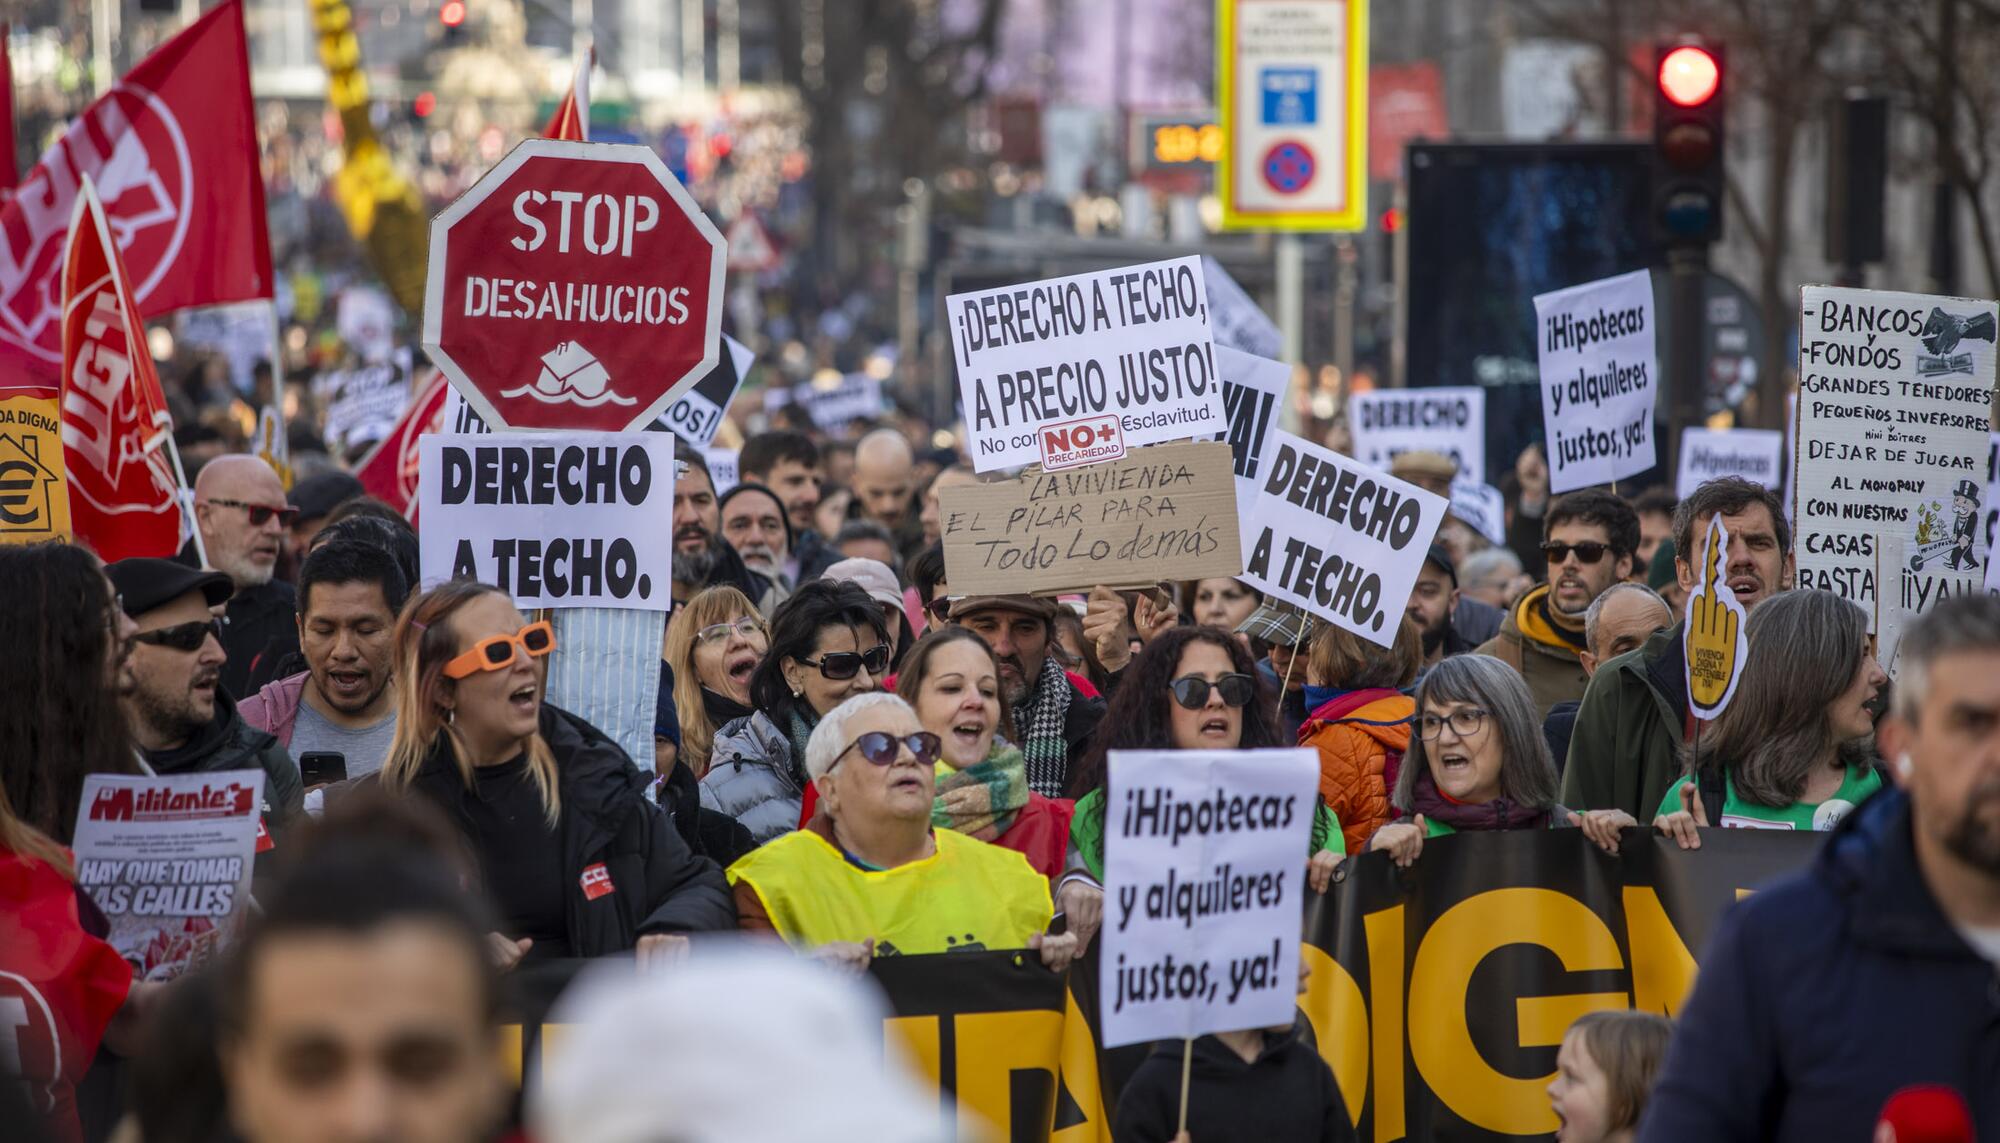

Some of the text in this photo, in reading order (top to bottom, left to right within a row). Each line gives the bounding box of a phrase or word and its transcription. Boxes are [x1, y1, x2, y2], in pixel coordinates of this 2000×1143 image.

[511, 190, 660, 257] STOP
[464, 276, 690, 325] DESAHUCIOS
[958, 265, 1206, 367] ¡DERECHO A TECHO,
[1548, 305, 1644, 353] ¡Hipotecas
[975, 342, 1218, 432] A PRECIO JUSTO!
[1551, 383, 1562, 416] y
[1568, 359, 1648, 408] alquileres
[1898, 381, 1992, 405] TENEDORES
[18, 411, 58, 435] DIGNA
[666, 399, 717, 440] OS!
[980, 437, 1006, 455] No
[1121, 404, 1216, 431] €sclavitud.
[1361, 397, 1469, 429] DERECHO
[1812, 401, 1990, 433] PEQUEÑOS INVERSORES
[1048, 444, 1120, 465] PRECARIEDAD
[1556, 409, 1647, 471] justos, ya!
[1809, 440, 1877, 461] DEJAR
[1885, 449, 1906, 462] DE
[1915, 451, 1975, 470] JUGAR
[441, 444, 652, 506] DERECHO
[1264, 443, 1421, 551] DERECHO
[1831, 476, 1925, 493] AL MONOPOLY
[945, 512, 986, 535] EL
[1101, 496, 1177, 523] PARA
[1807, 498, 1908, 522] CON NUESTRAS
[975, 515, 1220, 570] Todo Lo demás
[1806, 533, 1873, 557] CASAS
[452, 537, 652, 600] A TECHO.
[1247, 526, 1385, 632] A TECHO.
[89, 783, 227, 822] Militante
[1123, 787, 1295, 847] ¡Hipotecas
[79, 857, 242, 885] HAY QUE TOMAR
[84, 885, 235, 916] AS CALLES
[1118, 863, 1285, 932] y alquileres
[1114, 938, 1281, 1014] justos, ya!
